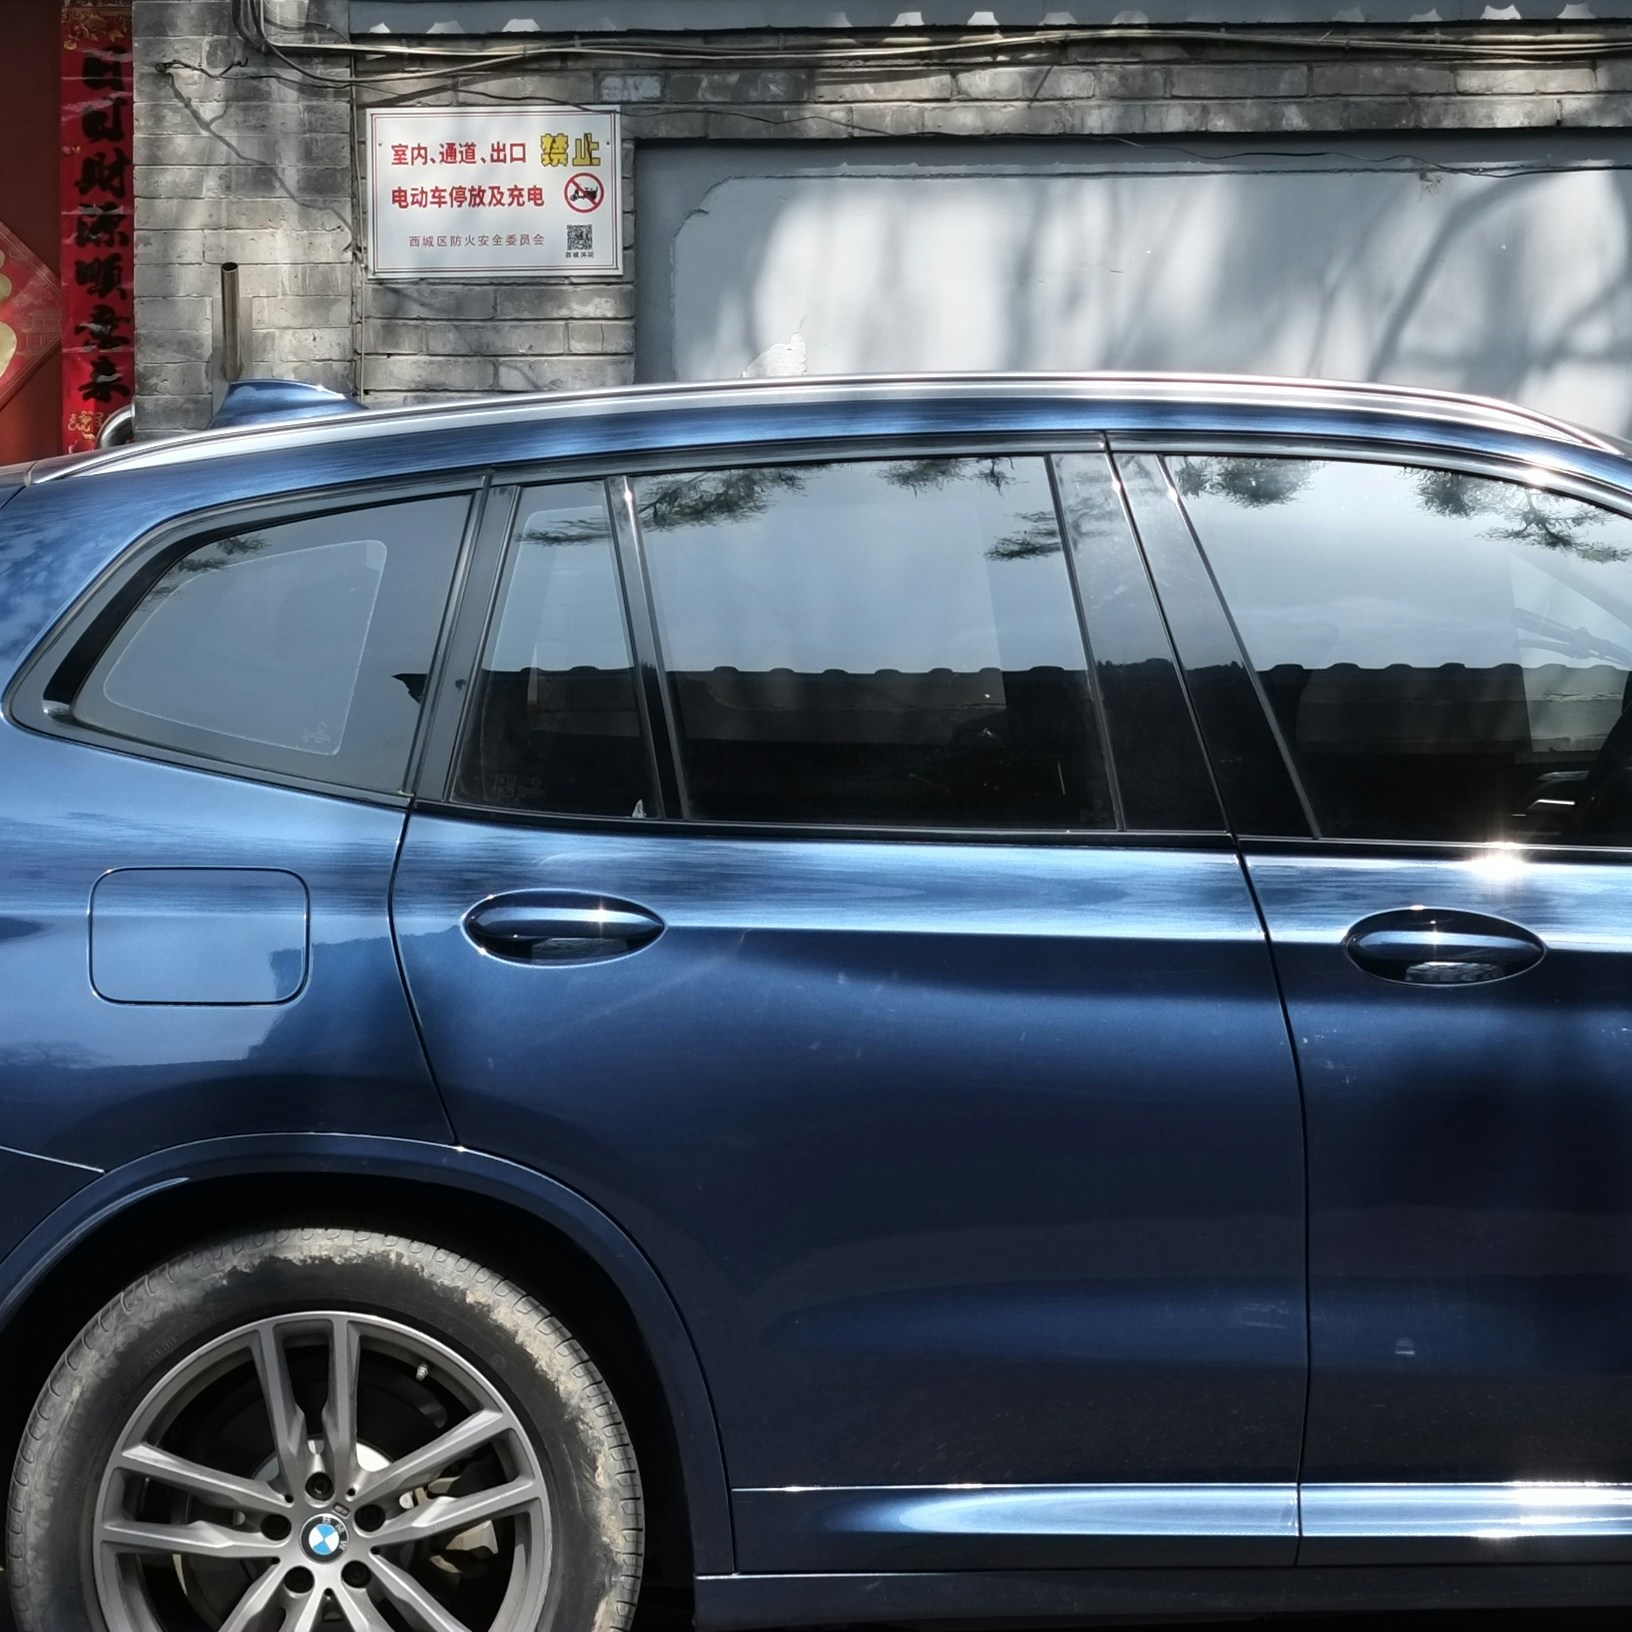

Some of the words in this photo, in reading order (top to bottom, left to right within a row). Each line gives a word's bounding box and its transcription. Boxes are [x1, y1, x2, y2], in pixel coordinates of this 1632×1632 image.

[391, 142, 527, 166] 室内、通道、出口
[540, 133, 601, 168] 禁止
[391, 184, 545, 209] 电动车停放及充电
[409, 233, 545, 247] 西城区防火安全委员会
